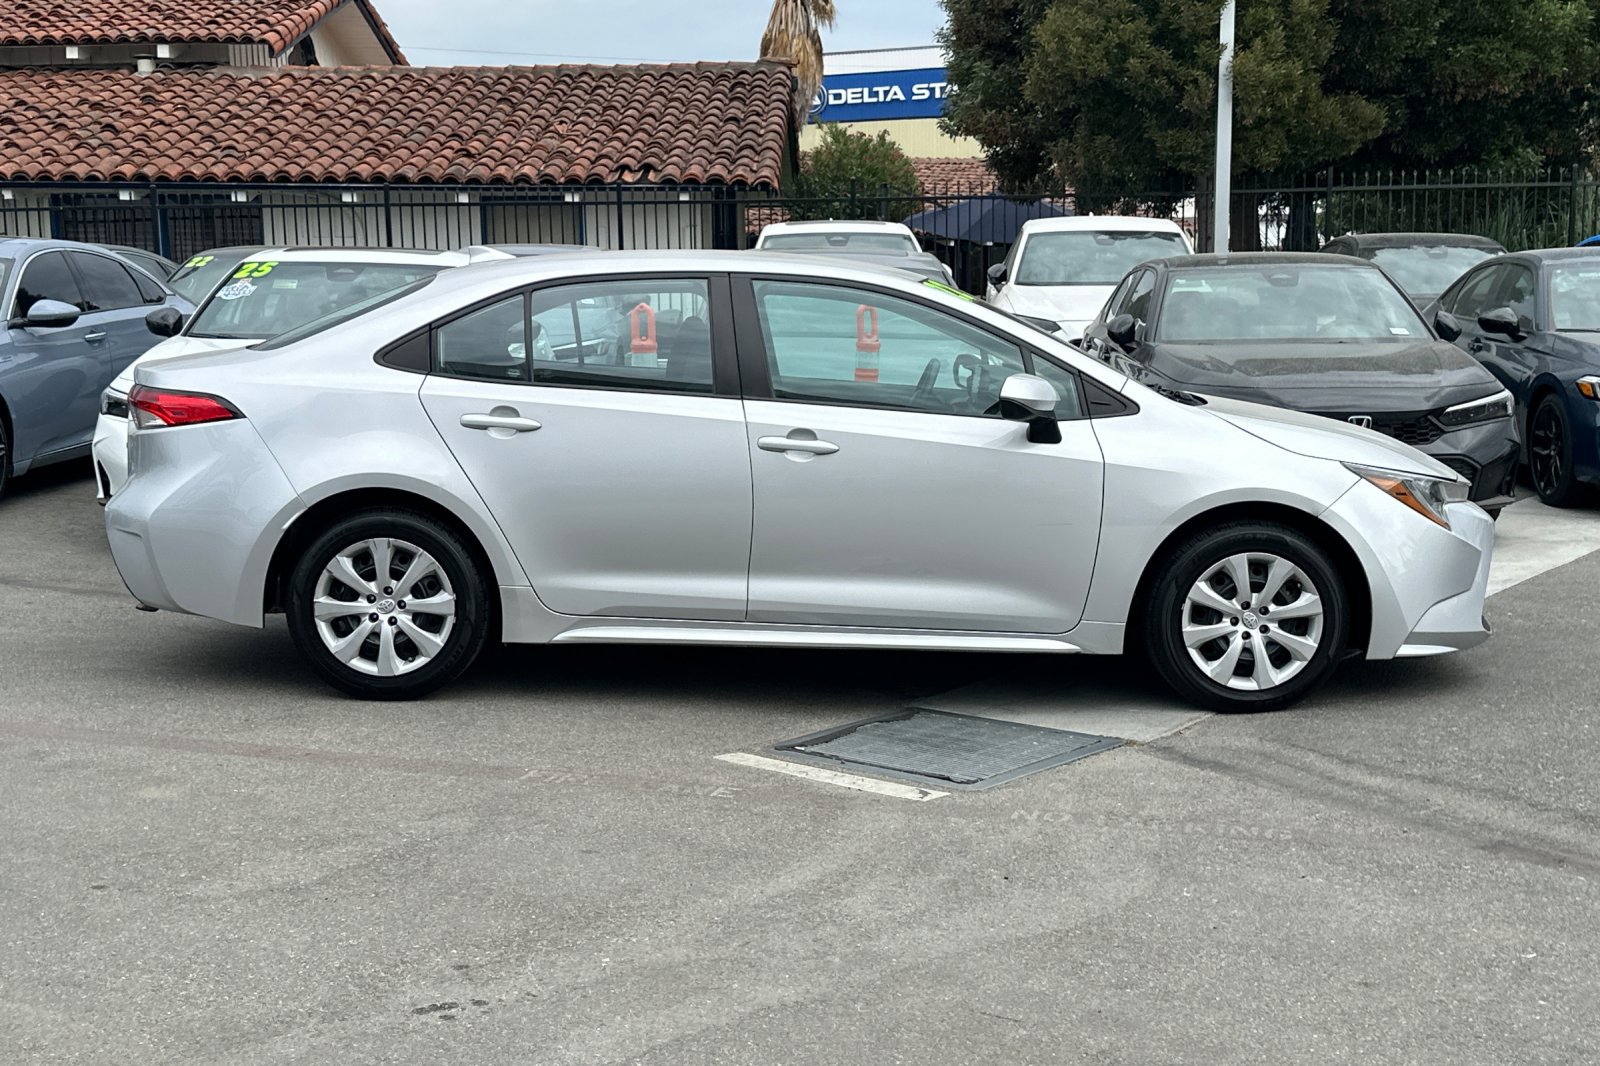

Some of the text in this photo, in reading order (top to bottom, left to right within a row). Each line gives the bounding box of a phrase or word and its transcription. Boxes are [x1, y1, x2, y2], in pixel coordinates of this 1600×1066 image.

[828, 85, 906, 105] DELTA
[184, 255, 215, 268] 22
[232, 261, 279, 279] 25
